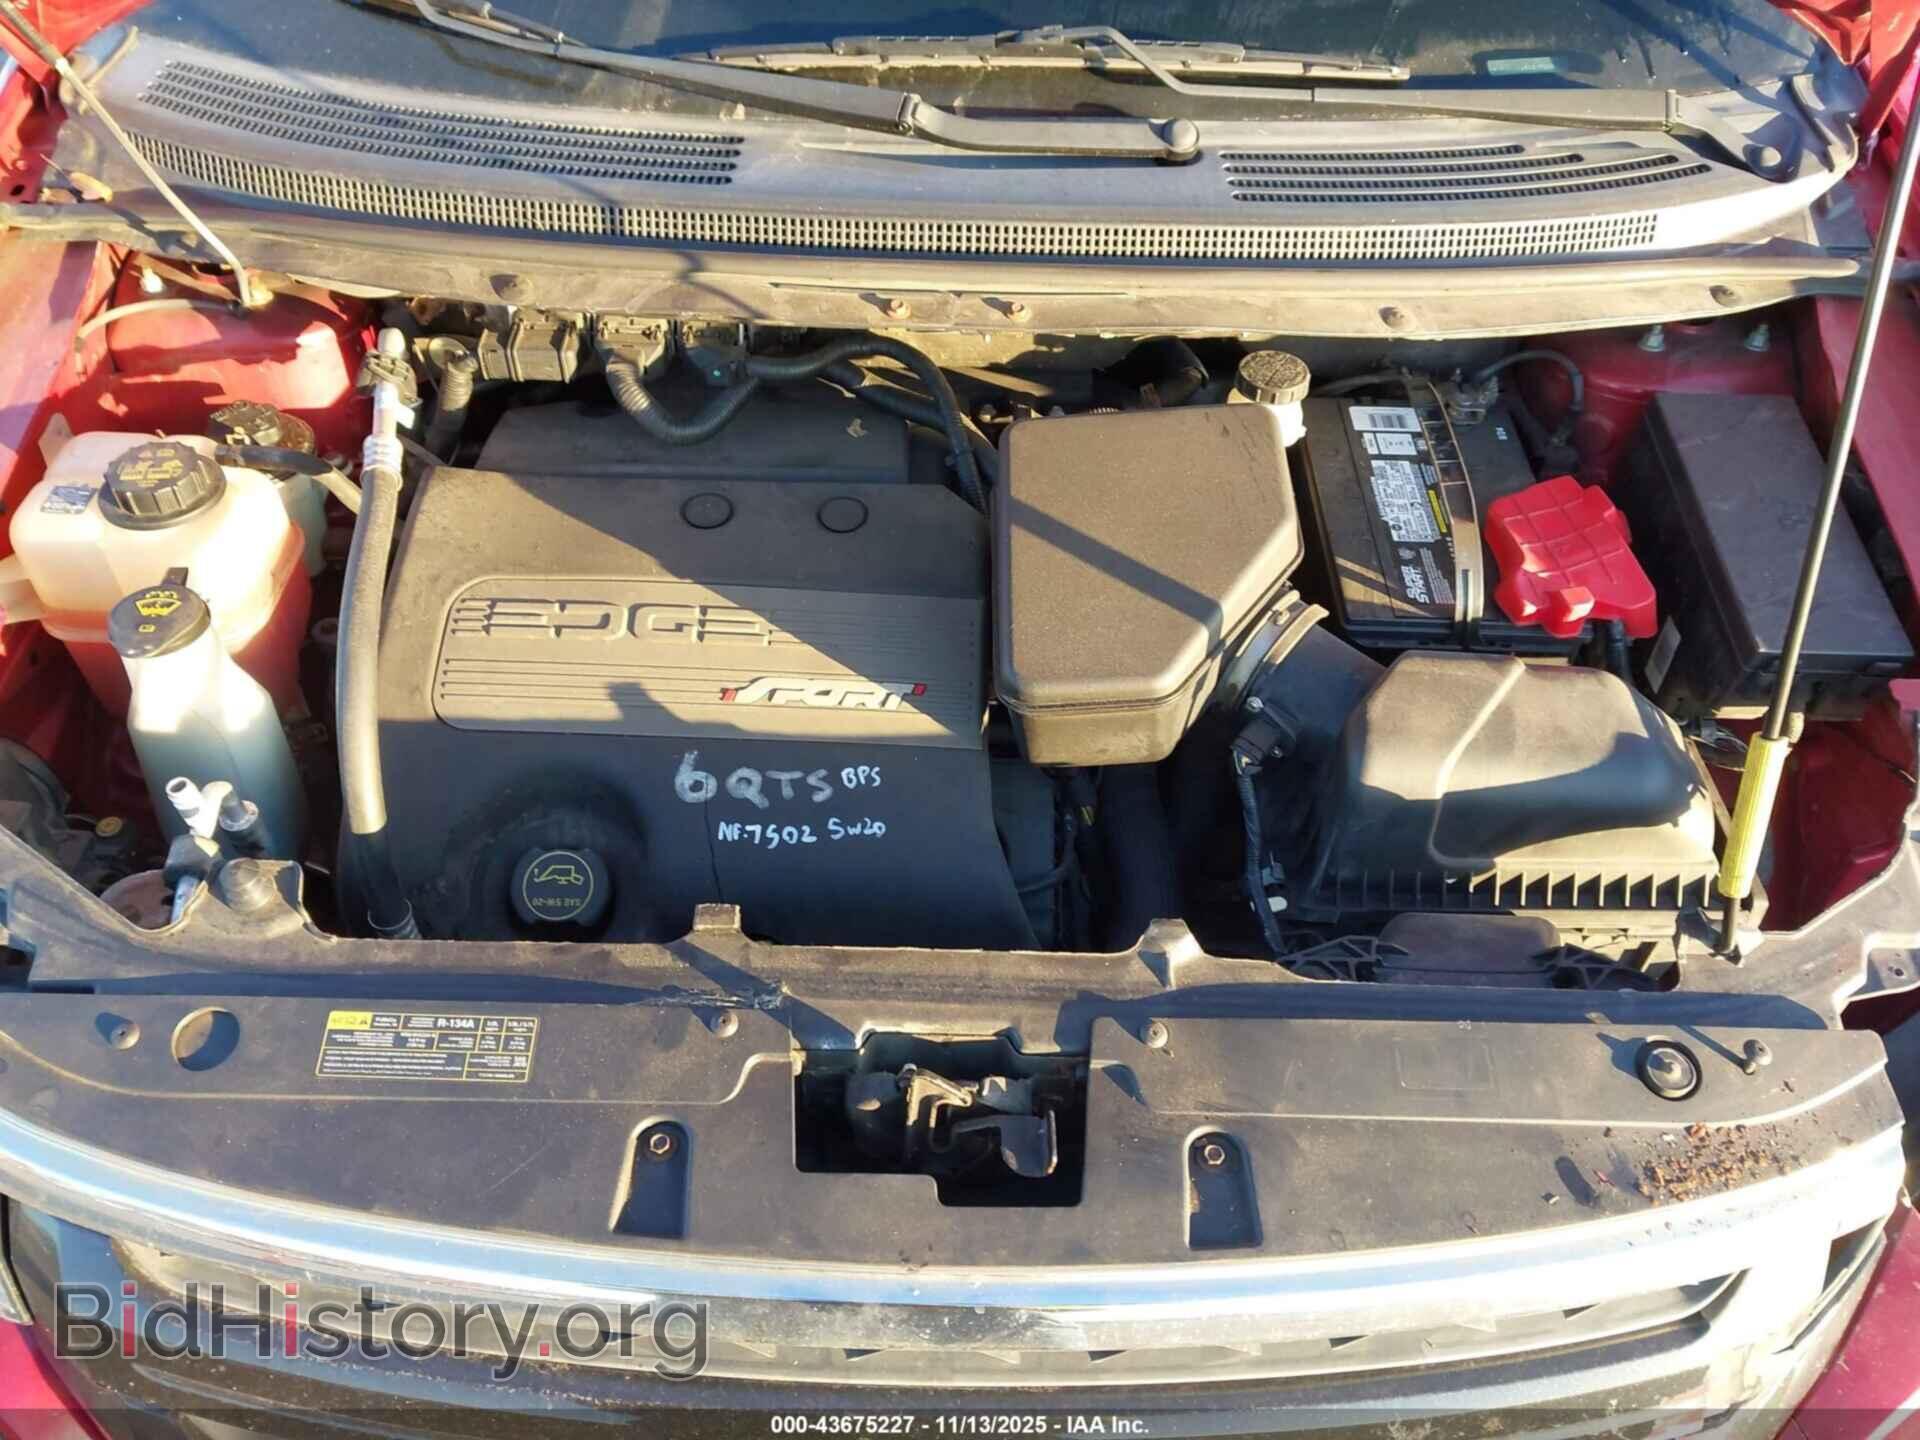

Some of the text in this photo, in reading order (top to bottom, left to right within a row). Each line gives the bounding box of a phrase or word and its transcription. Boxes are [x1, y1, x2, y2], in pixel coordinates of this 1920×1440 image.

[455, 597, 773, 646] EDGE
[720, 676, 928, 711] SPORT
[840, 765, 882, 789] BPS
[436, 1018, 476, 1030] R-134A
